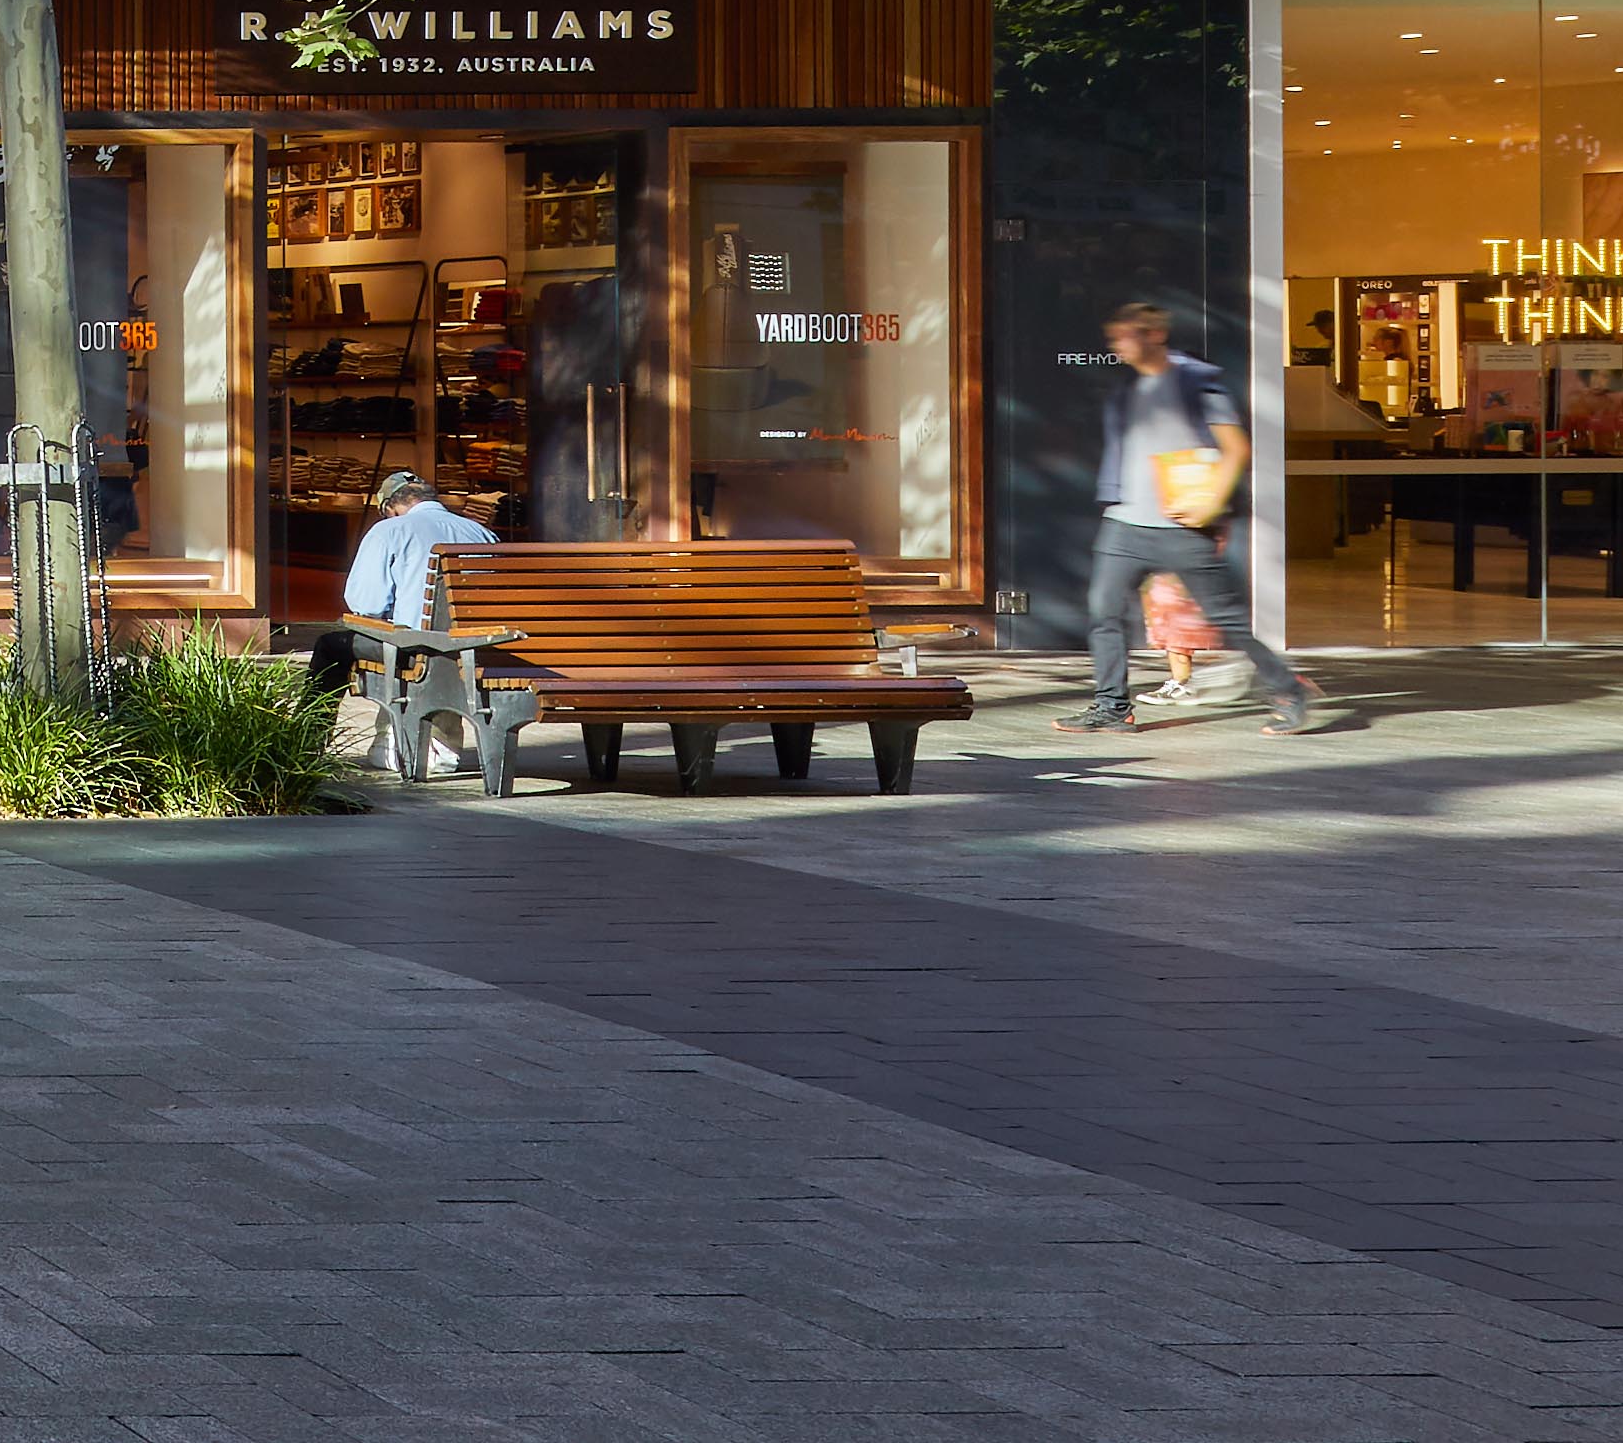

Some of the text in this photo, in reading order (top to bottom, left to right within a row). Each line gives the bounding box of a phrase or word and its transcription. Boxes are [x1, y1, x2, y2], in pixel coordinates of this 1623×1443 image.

[367, 9, 676, 41] WILLIAMS
[456, 56, 597, 73] AUSTRALIA
[1481, 238, 1623, 276] THIN
[755, 313, 900, 343] YARDBOOT365
[1484, 296, 1623, 334] THIN
[79, 321, 158, 351] OOT365
[1057, 352, 1088, 366] FIRE
